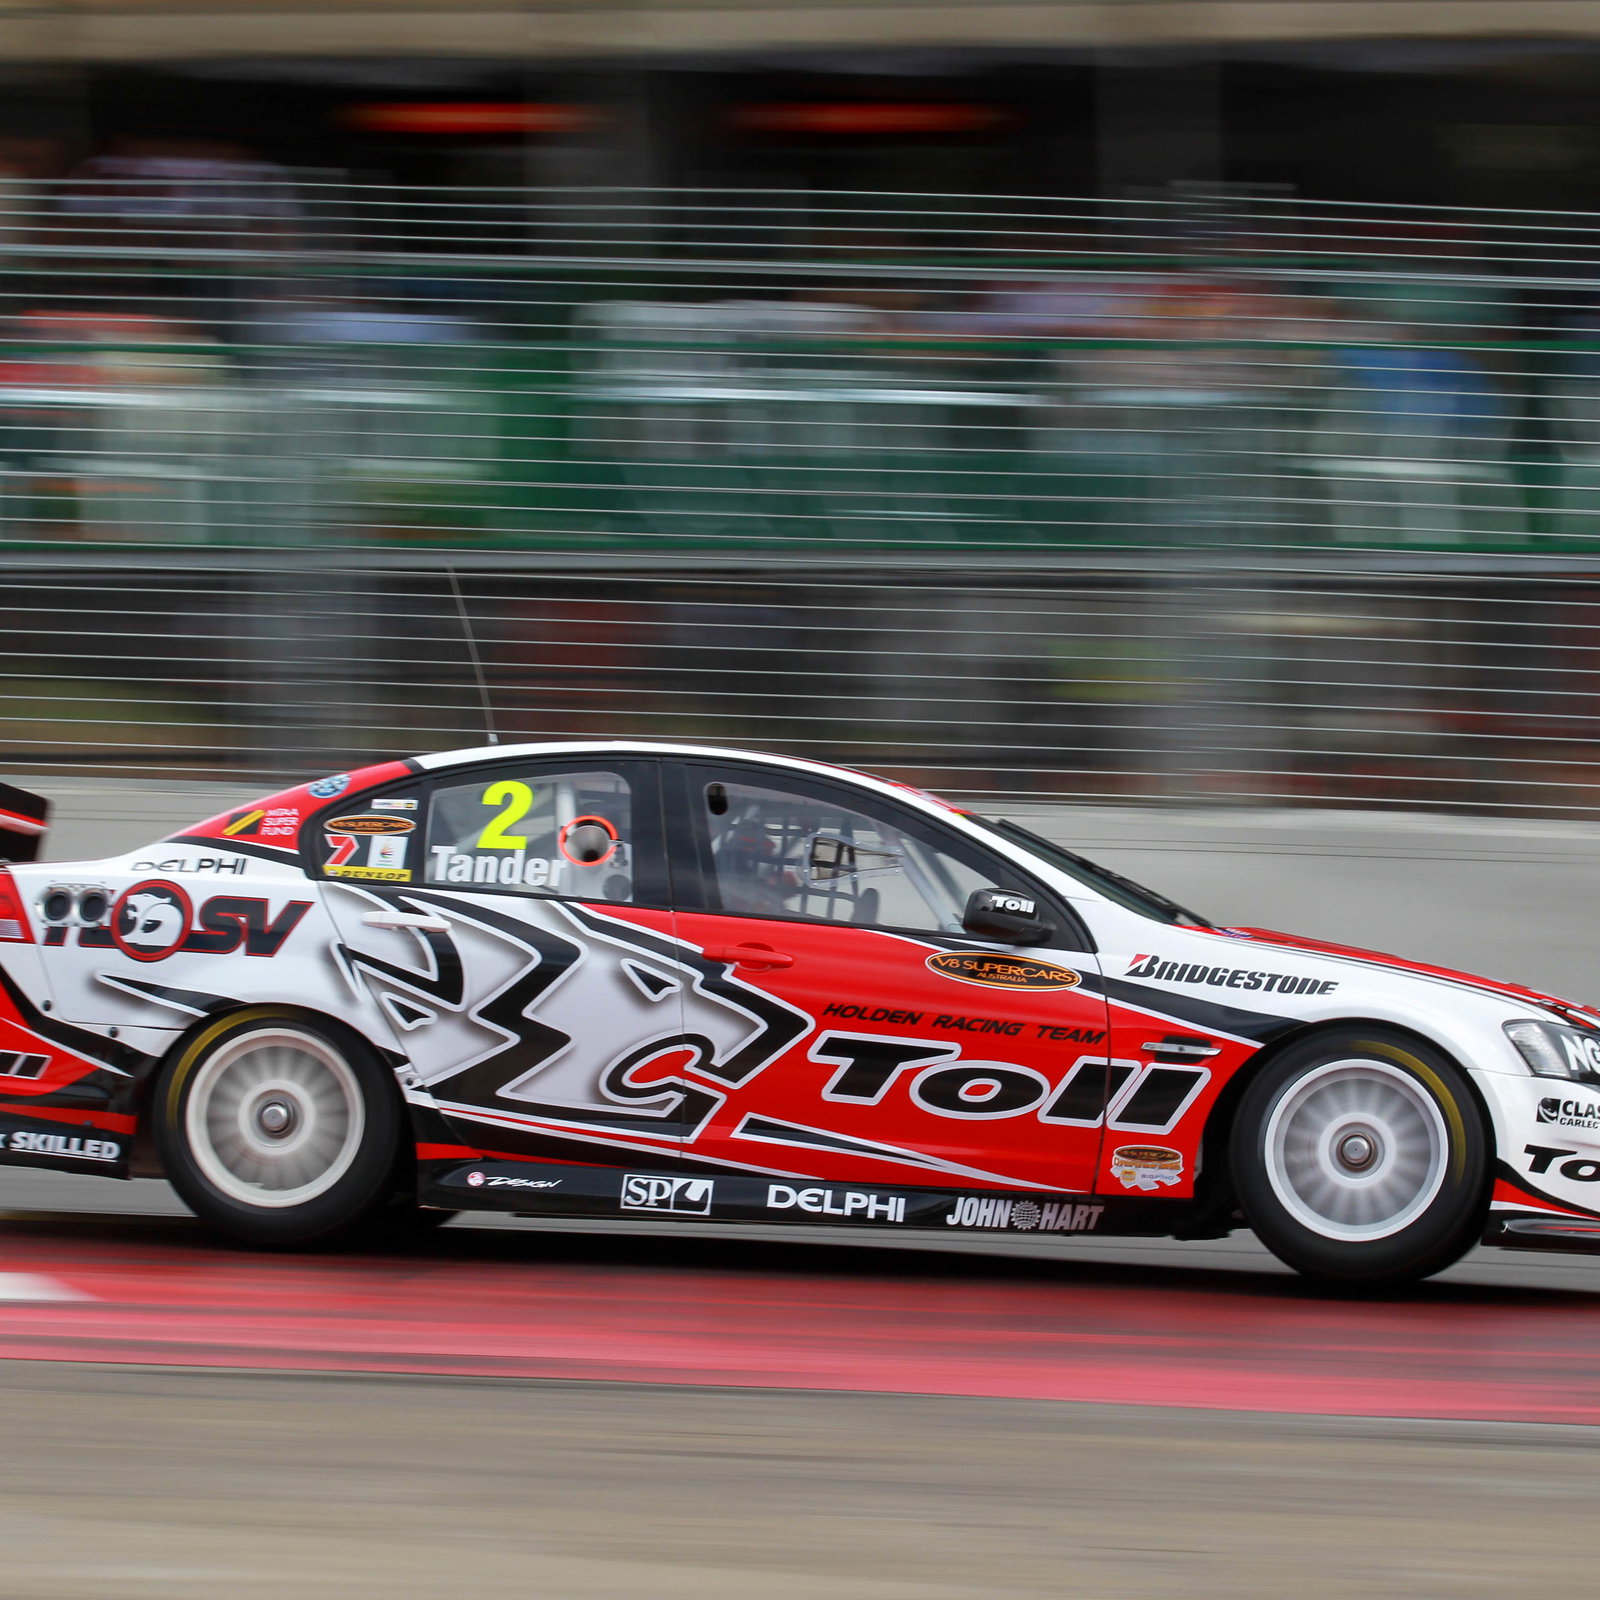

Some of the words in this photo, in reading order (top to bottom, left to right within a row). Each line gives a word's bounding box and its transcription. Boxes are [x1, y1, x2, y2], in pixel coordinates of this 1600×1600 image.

[262, 817, 299, 826] SUPER
[476, 780, 533, 850] 2
[260, 827, 295, 836] FUND
[324, 834, 360, 866] 7
[132, 858, 247, 875] DELPHI
[341, 870, 408, 880] DUNLOP
[431, 845, 568, 886] Tander
[991, 896, 1035, 914] Toll
[935, 956, 960, 968] V8
[962, 960, 1077, 982] SUPERCARS
[977, 972, 1027, 983] AUSTRALIA
[1124, 954, 1340, 995] BRIDGESTONE
[821, 1003, 923, 1026] HOLDEN
[931, 1015, 1025, 1036] RACING
[1036, 1025, 1106, 1045] TEAM
[807, 1030, 1211, 1135] Toll
[1562, 1100, 1600, 1120] CLA
[1560, 1118, 1600, 1130] CARLEC
[10, 1131, 120, 1160] SKILLED
[766, 1184, 905, 1222] DELPHI
[946, 1197, 1011, 1227] JOHN
[1038, 1202, 1105, 1232] HART
